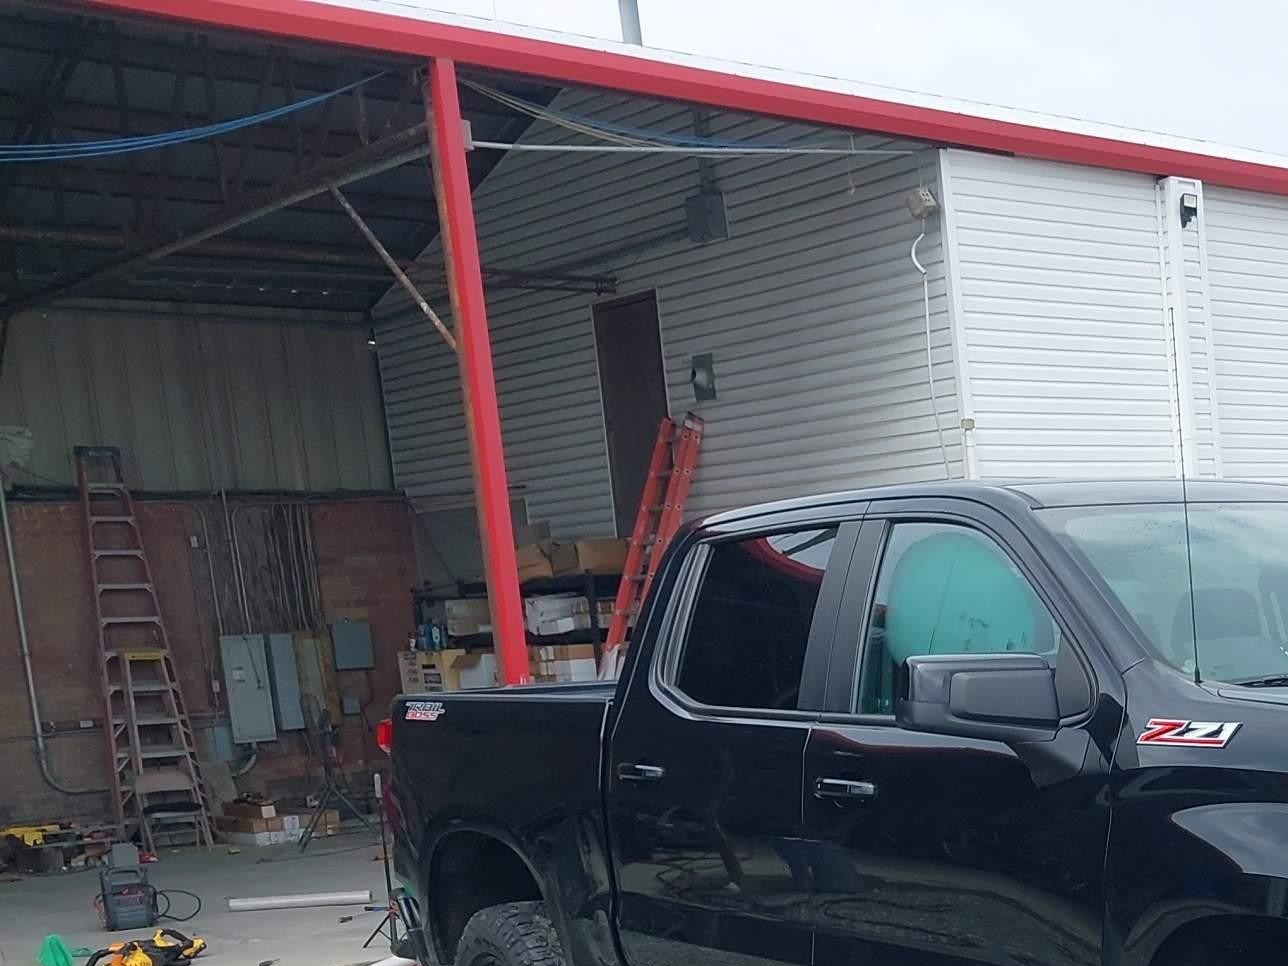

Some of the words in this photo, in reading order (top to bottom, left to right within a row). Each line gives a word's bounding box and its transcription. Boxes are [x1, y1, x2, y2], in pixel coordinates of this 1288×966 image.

[405, 701, 446, 714] TRAIL
[405, 710, 439, 721] BOSS
[1136, 718, 1243, 749] Z71
